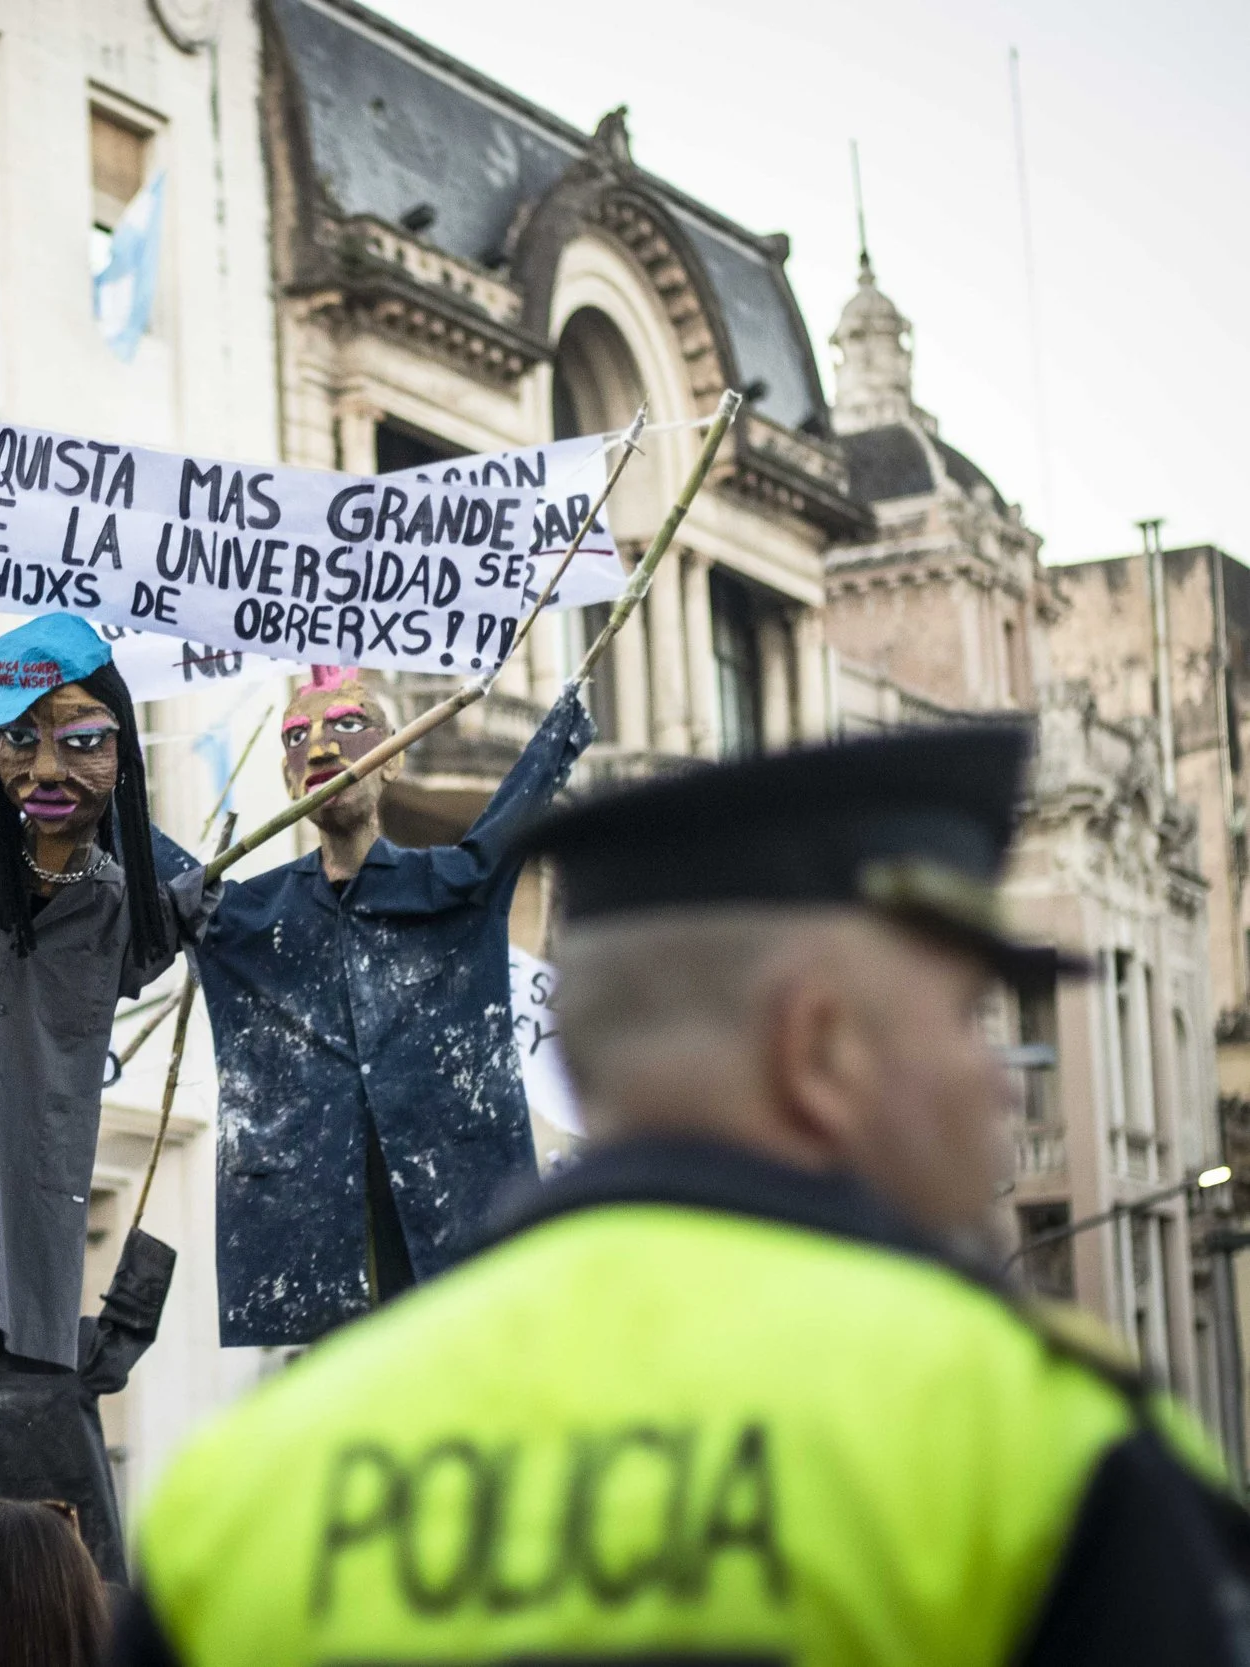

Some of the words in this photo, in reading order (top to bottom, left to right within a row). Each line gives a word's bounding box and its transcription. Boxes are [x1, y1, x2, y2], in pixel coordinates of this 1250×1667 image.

[179, 458, 281, 530] MAS
[326, 483, 521, 551] GRANDE
[61, 506, 122, 570] LA
[157, 522, 461, 608] UNIVERSIDAD
[475, 552, 524, 589] SE
[130, 581, 182, 625] DE
[308, 1420, 790, 1622] POLICIA
